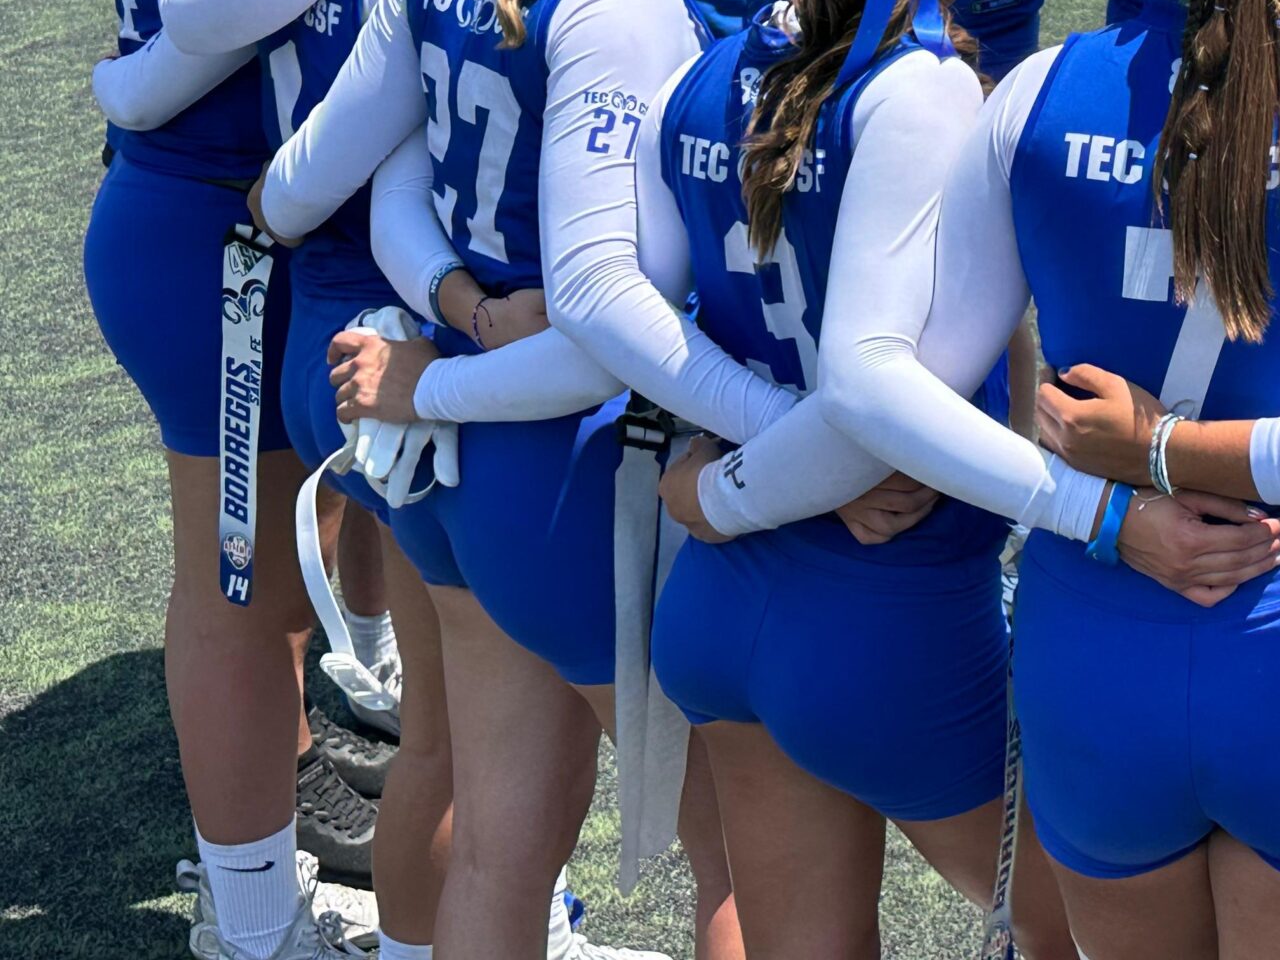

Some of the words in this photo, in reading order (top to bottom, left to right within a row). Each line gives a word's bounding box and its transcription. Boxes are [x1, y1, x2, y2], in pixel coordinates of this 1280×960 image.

[583, 91, 609, 104] TEC
[420, 41, 522, 263] 27
[586, 107, 641, 160] 27
[679, 134, 730, 183] TEC
[1064, 132, 1146, 185] TEC
[250, 335, 263, 354] FE
[249, 360, 263, 406] SANTA
[224, 356, 252, 525] BORREGOS
[227, 574, 249, 601] 14
